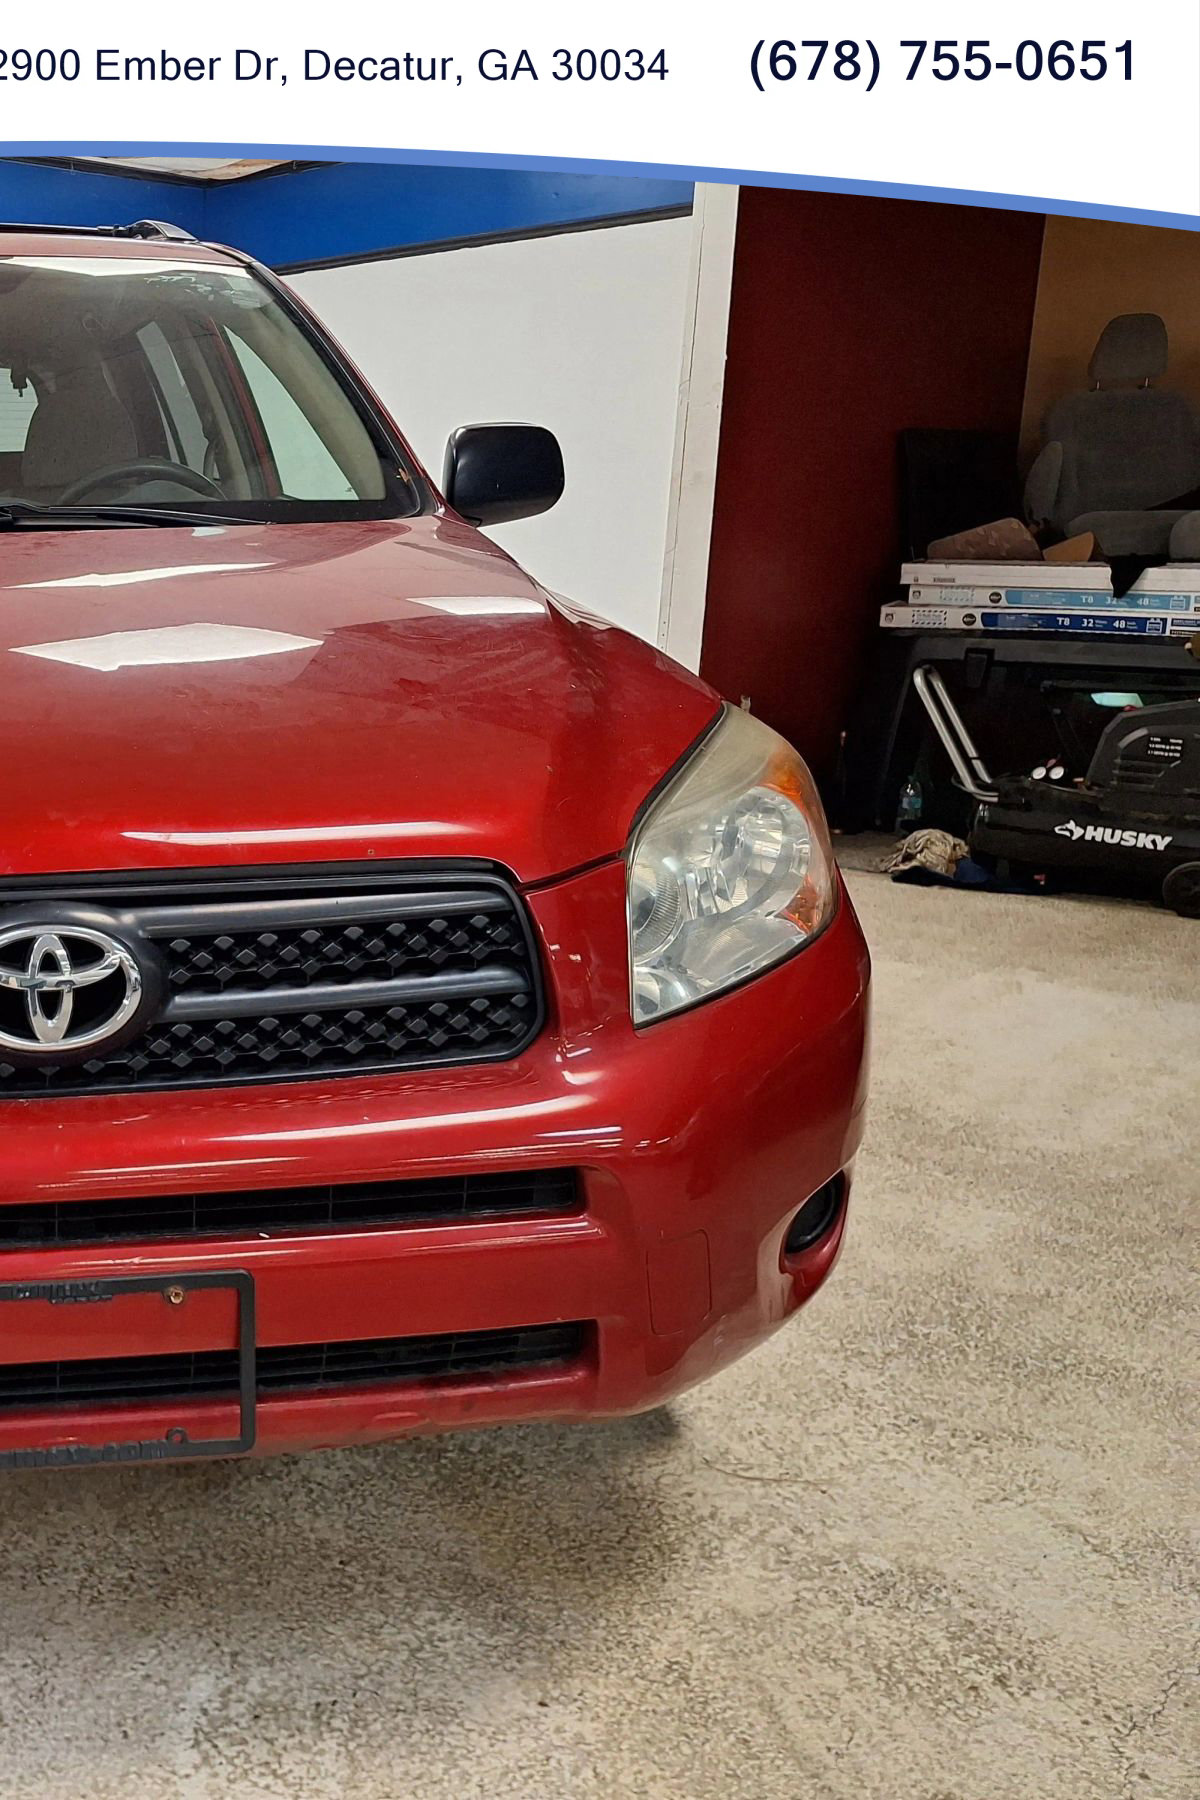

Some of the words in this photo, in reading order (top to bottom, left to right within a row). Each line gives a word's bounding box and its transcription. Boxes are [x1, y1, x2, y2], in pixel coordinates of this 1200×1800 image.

[1056, 616, 1071, 627] T8
[1081, 618, 1094, 628] 32
[1112, 619, 1126, 629] 48
[1084, 825, 1173, 851] HUSKY
